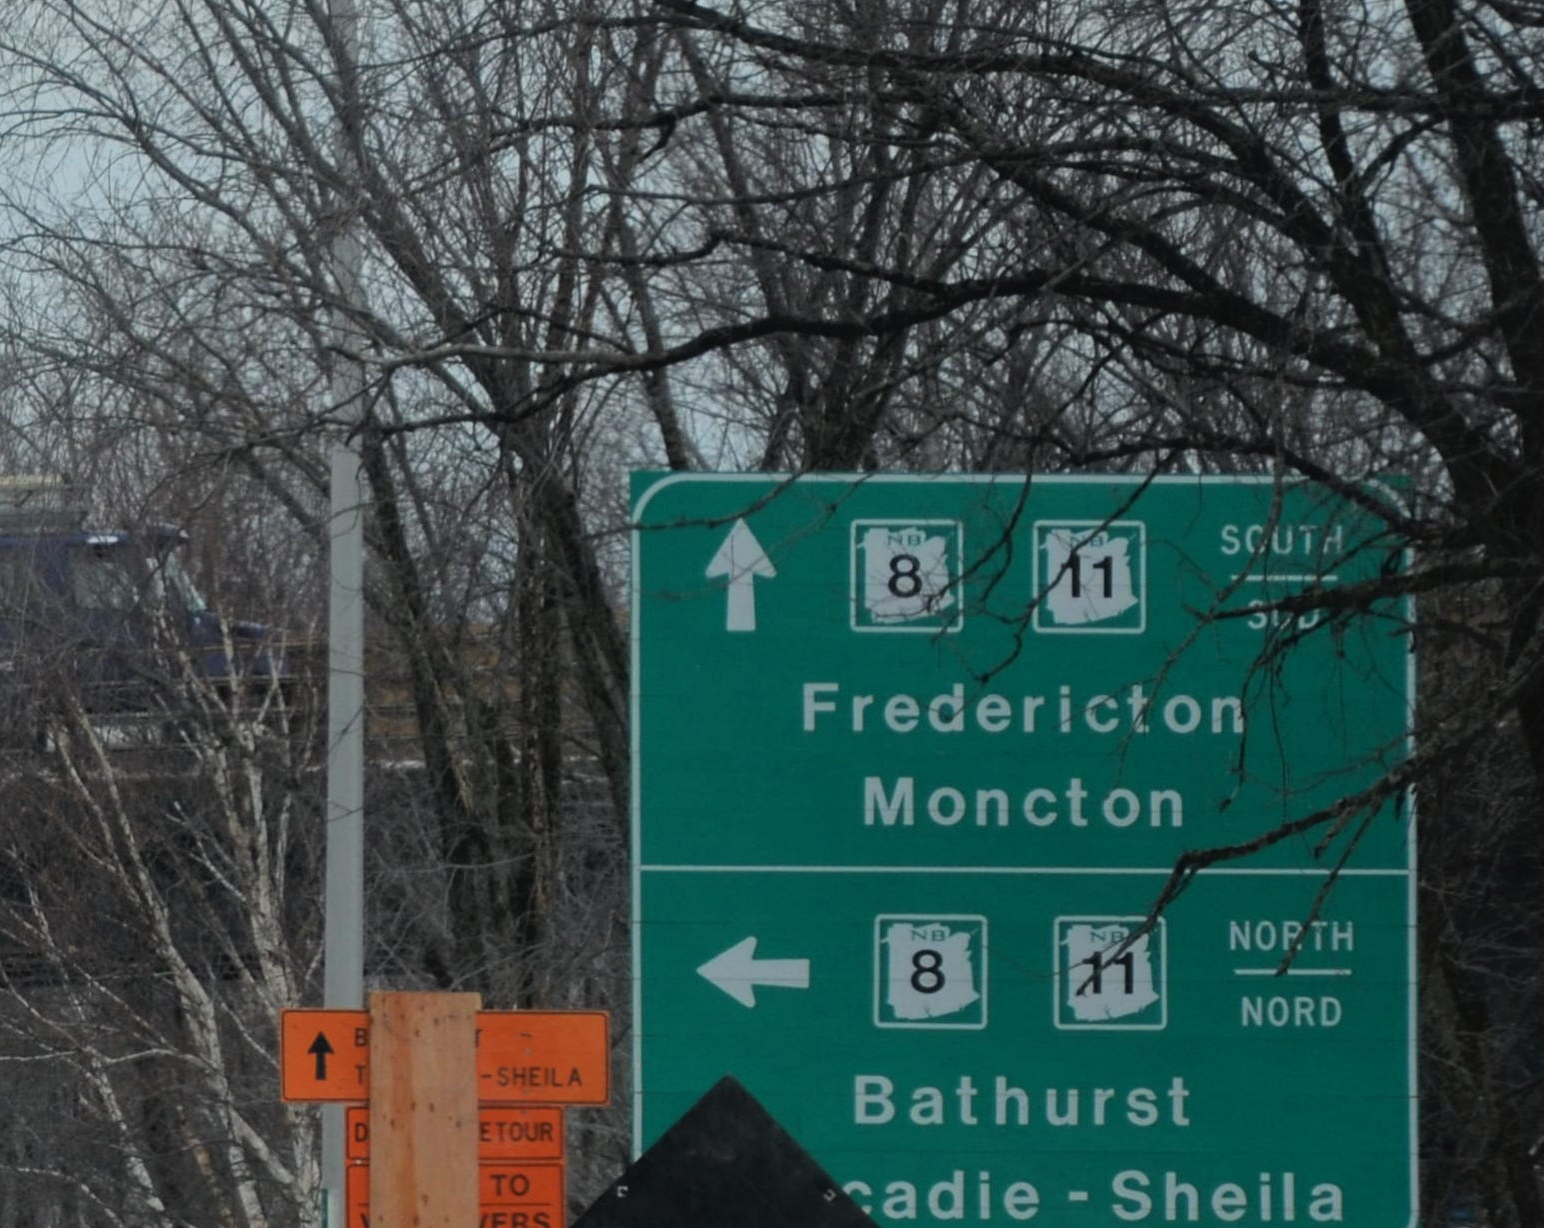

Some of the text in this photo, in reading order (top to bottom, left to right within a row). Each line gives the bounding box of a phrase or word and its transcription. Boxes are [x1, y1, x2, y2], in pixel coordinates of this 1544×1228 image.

[888, 534, 922, 546] NB
[1221, 524, 1343, 555] SOUTH
[887, 554, 923, 598] 8
[1061, 553, 1113, 598] 11
[802, 682, 1245, 734] Fredericton
[863, 776, 1184, 827] Moncton
[910, 929, 946, 942] NB
[1089, 930, 1124, 943] NB
[1229, 920, 1354, 951] NORTH
[910, 949, 946, 995] 8
[1082, 951, 1134, 995] 11
[1241, 996, 1342, 1027] NORD
[853, 1074, 1191, 1127] Bathurst
[479, 1121, 553, 1143] ETOUR
[490, 1174, 530, 1197] TO
[842, 1170, 1040, 1220] cadie
[1111, 1170, 1344, 1221] Sheila
